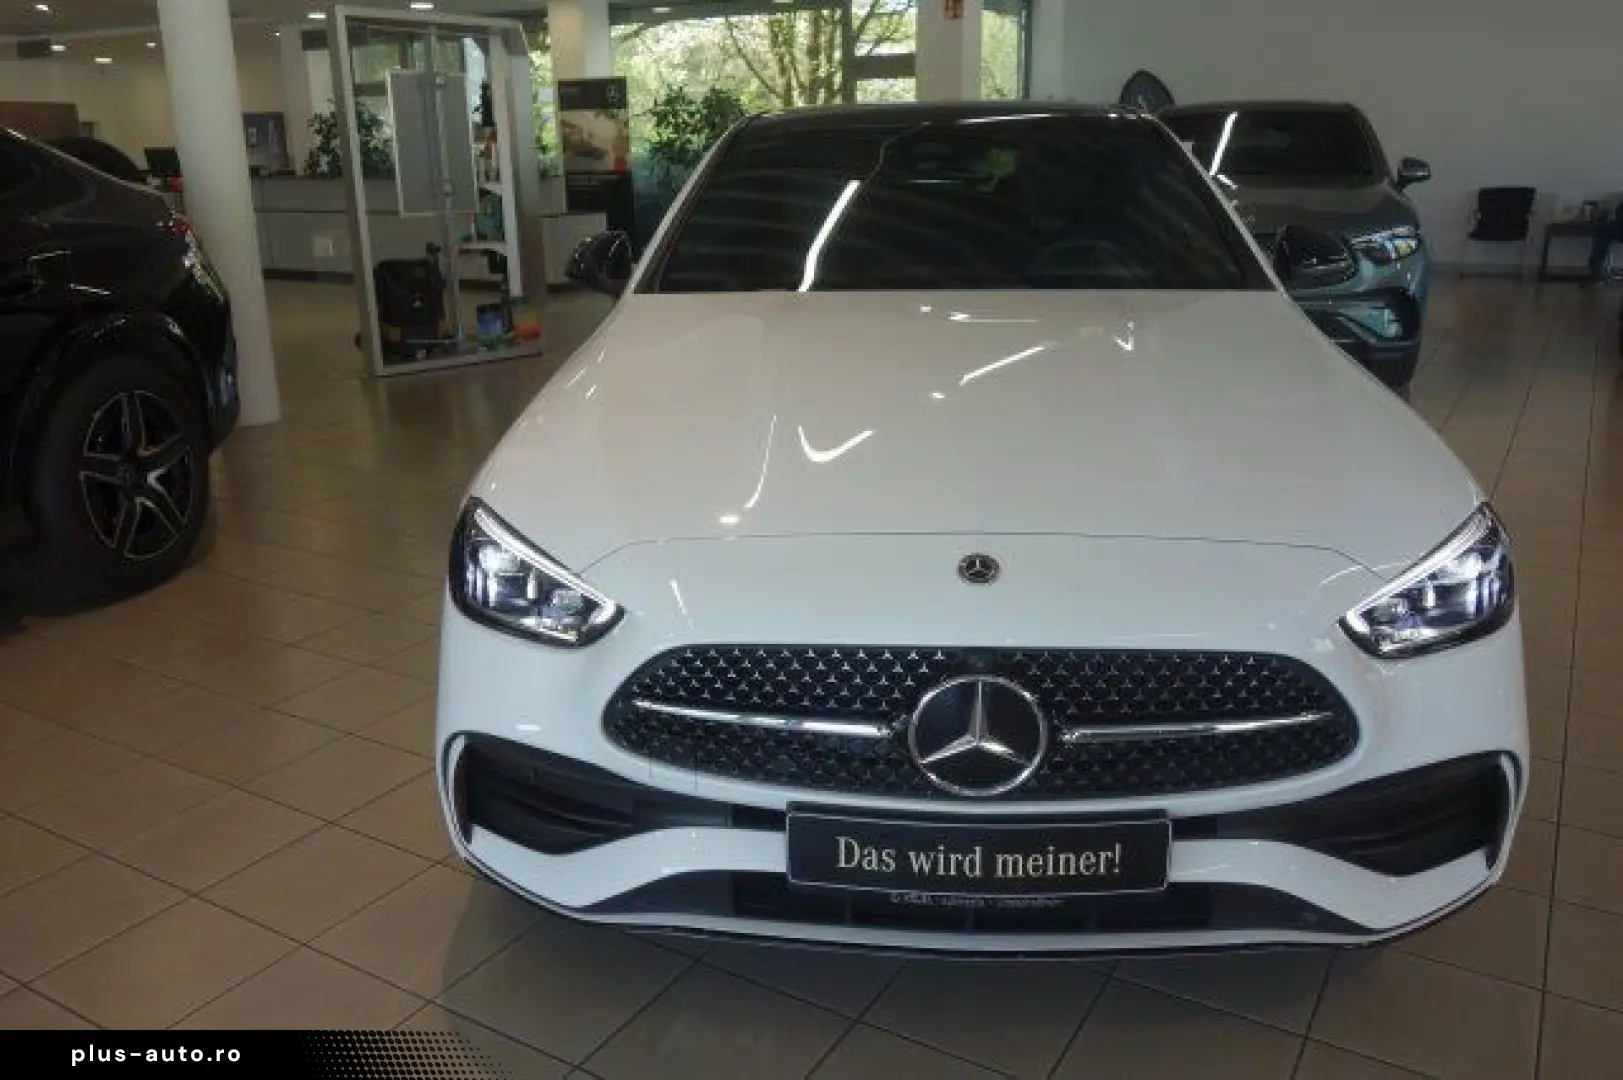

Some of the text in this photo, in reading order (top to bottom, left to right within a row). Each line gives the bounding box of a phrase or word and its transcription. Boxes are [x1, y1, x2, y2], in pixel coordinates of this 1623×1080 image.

[835, 836, 1123, 878] Das wird meiner!
